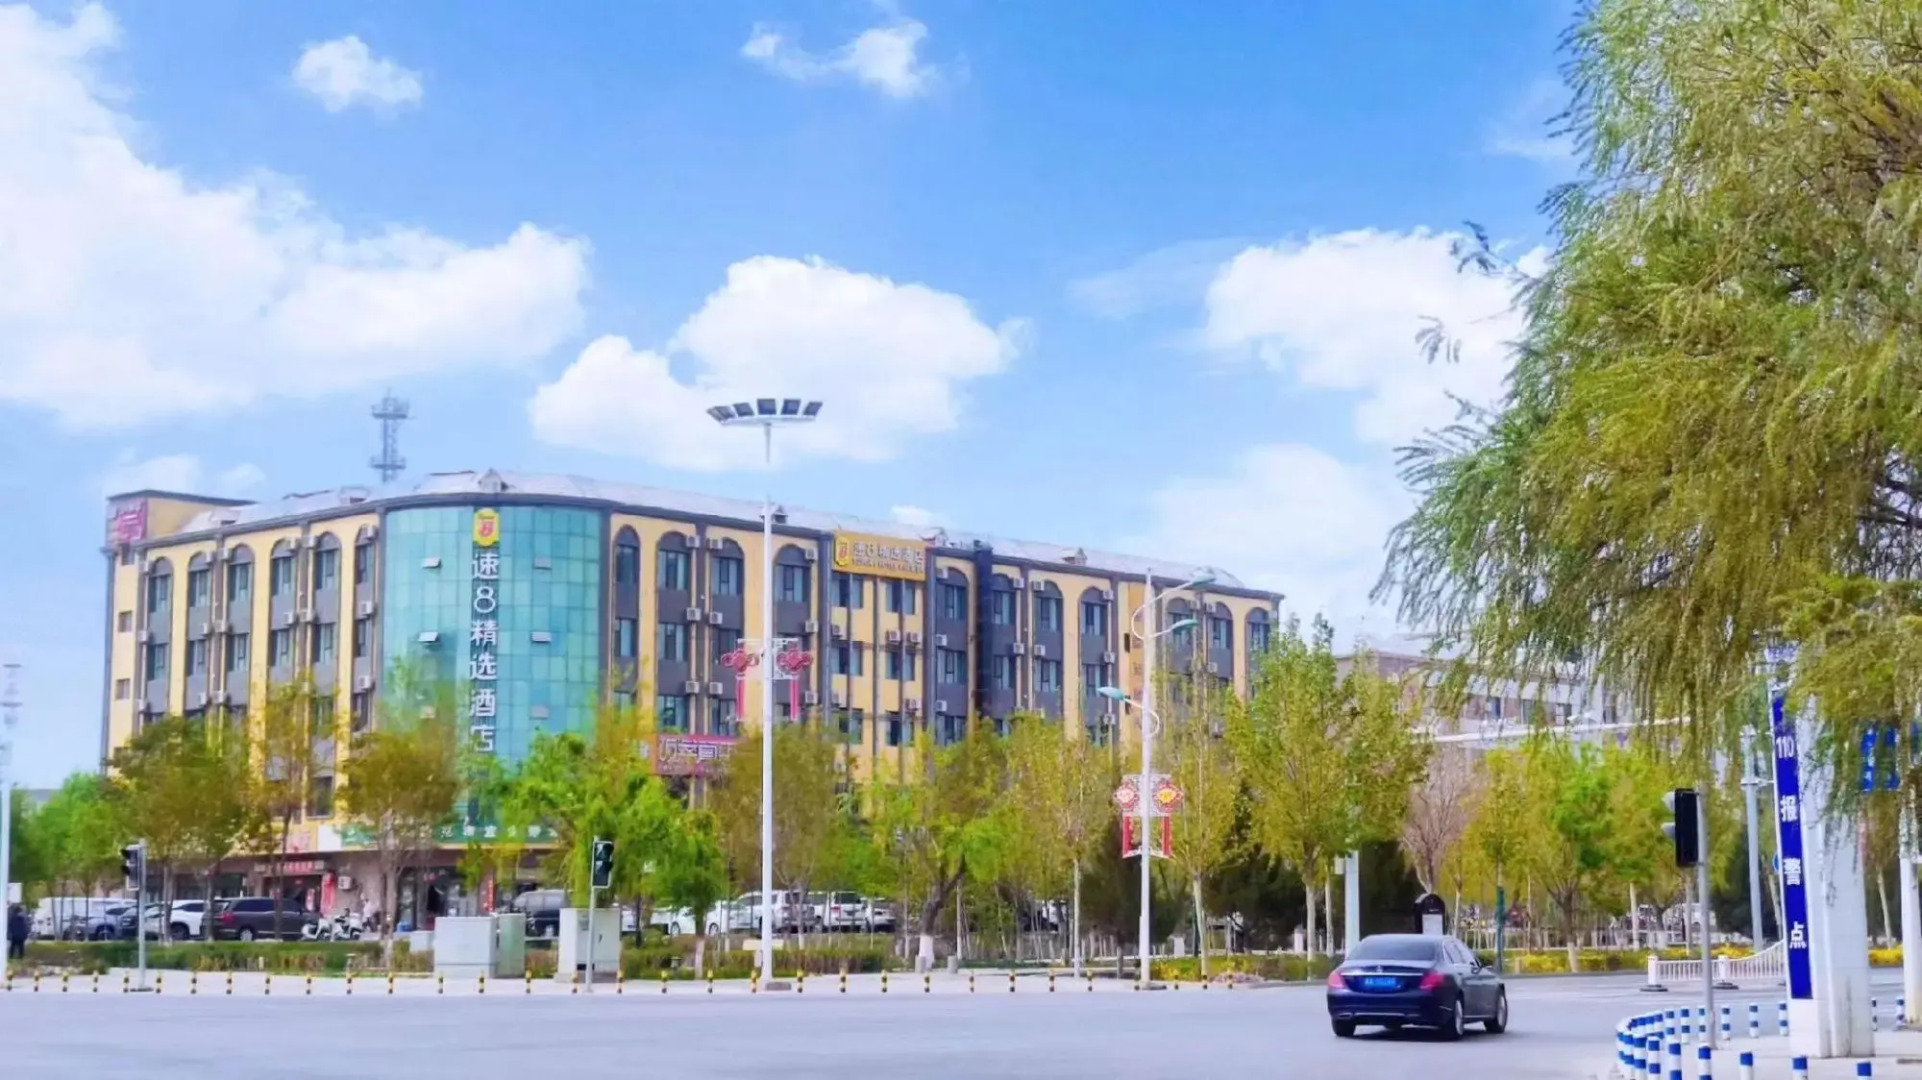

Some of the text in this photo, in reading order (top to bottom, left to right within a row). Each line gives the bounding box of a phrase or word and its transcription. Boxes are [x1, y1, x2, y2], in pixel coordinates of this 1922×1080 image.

[470, 552, 500, 753] 速8精选酒店
[1775, 735, 1807, 949] 110报警点
